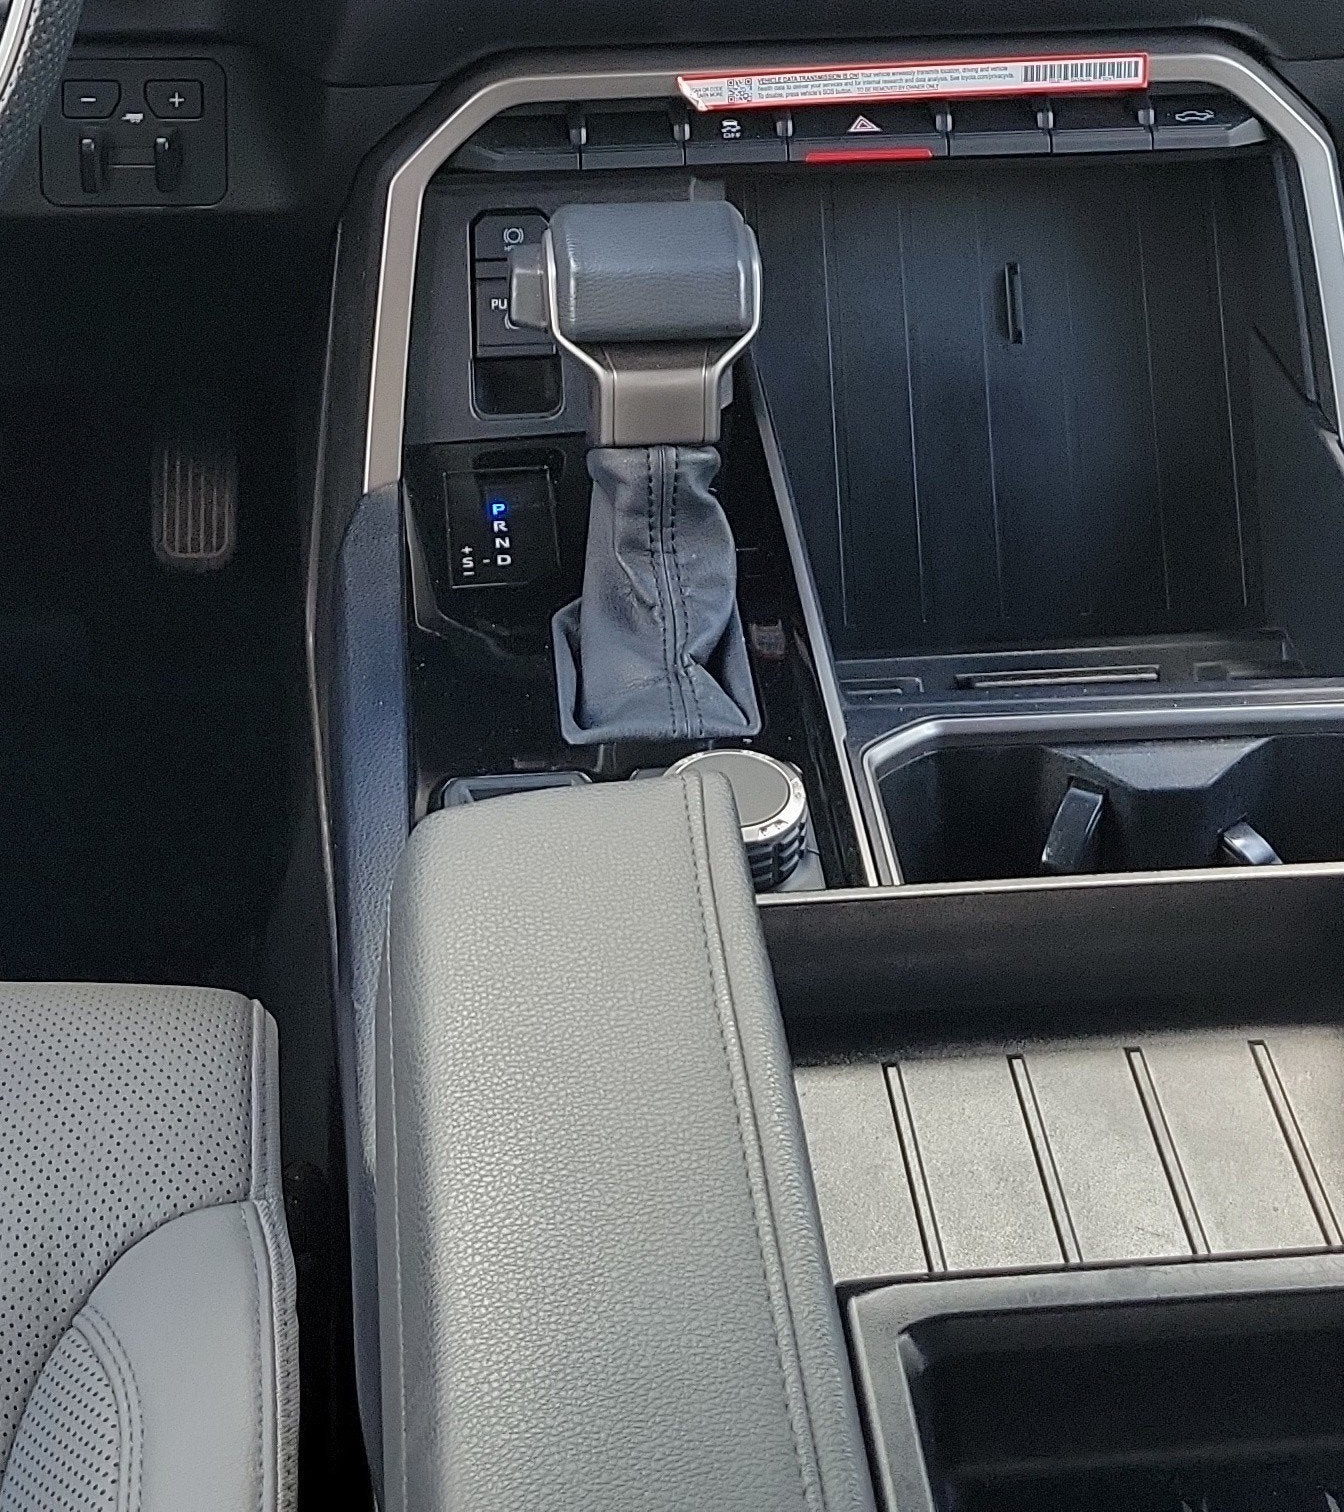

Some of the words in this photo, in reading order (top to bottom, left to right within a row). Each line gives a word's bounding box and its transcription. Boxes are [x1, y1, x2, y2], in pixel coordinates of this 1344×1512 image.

[492, 503, 505, 516] P
[494, 521, 508, 532] R
[495, 537, 510, 549] N
[462, 556, 474, 568] S
[497, 554, 511, 566] D
